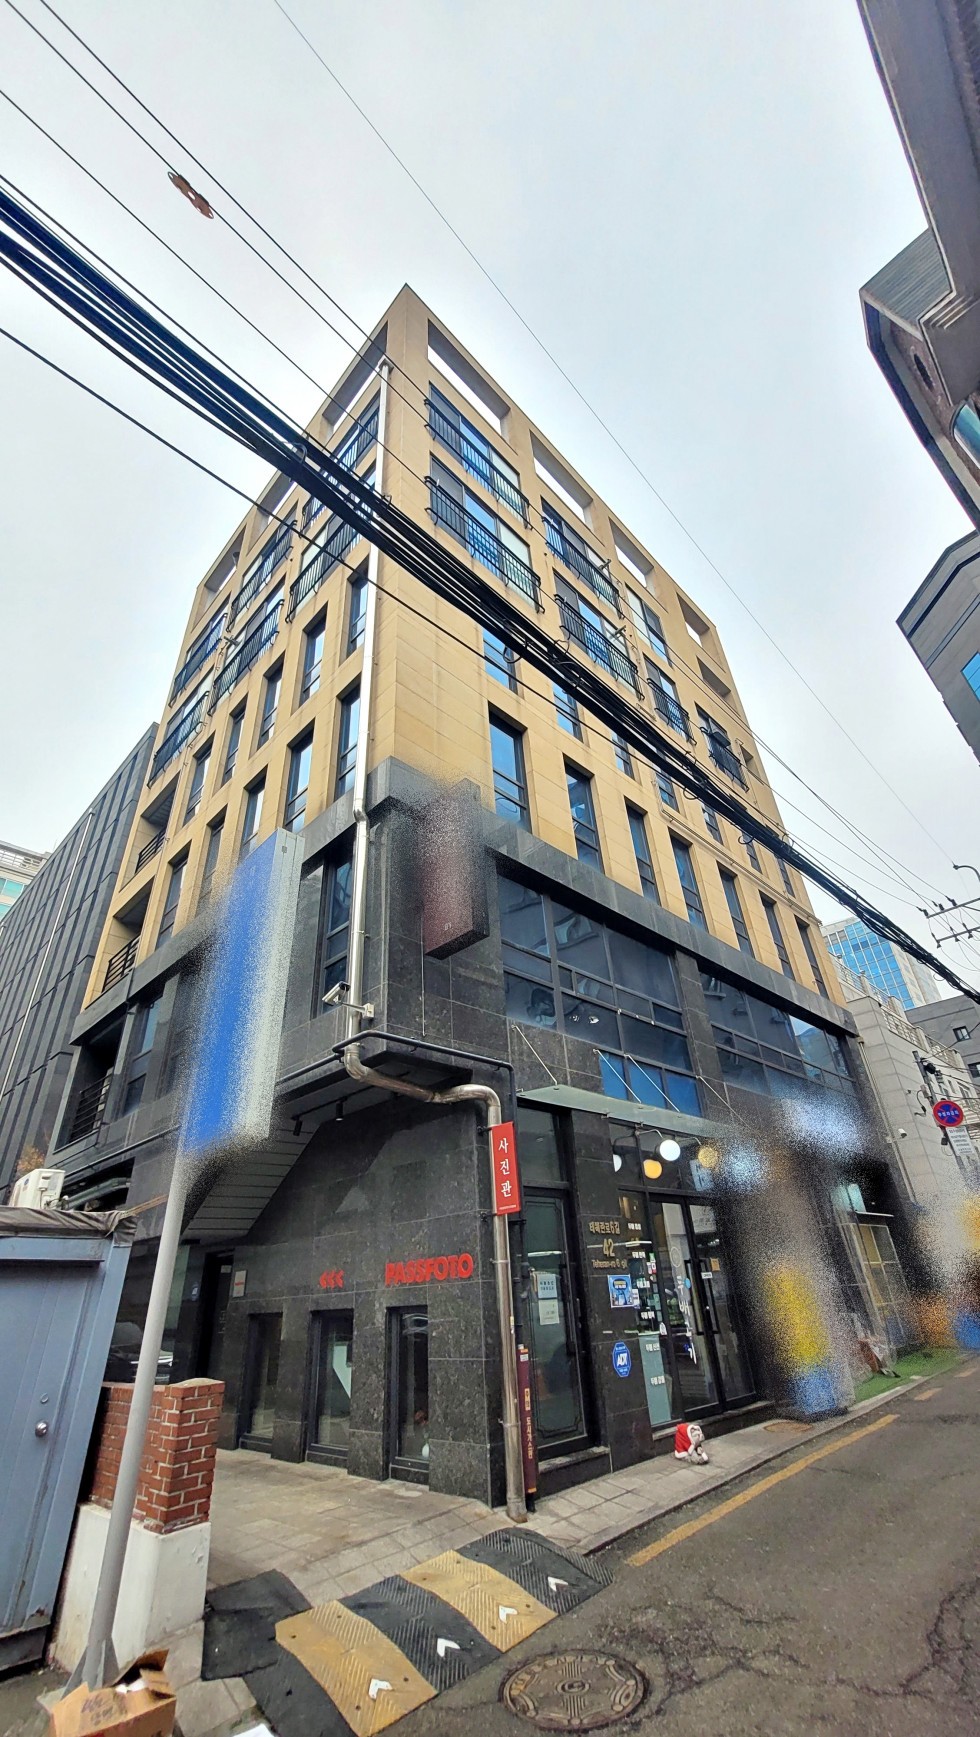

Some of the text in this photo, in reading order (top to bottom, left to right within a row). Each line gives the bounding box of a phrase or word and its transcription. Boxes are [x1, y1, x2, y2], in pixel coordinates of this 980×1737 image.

[498, 1137, 512, 1198] 사진관
[589, 1221, 620, 1235] 테헤란로6길
[602, 1238, 616, 1257] 42
[385, 1252, 474, 1287] PASSFOTO
